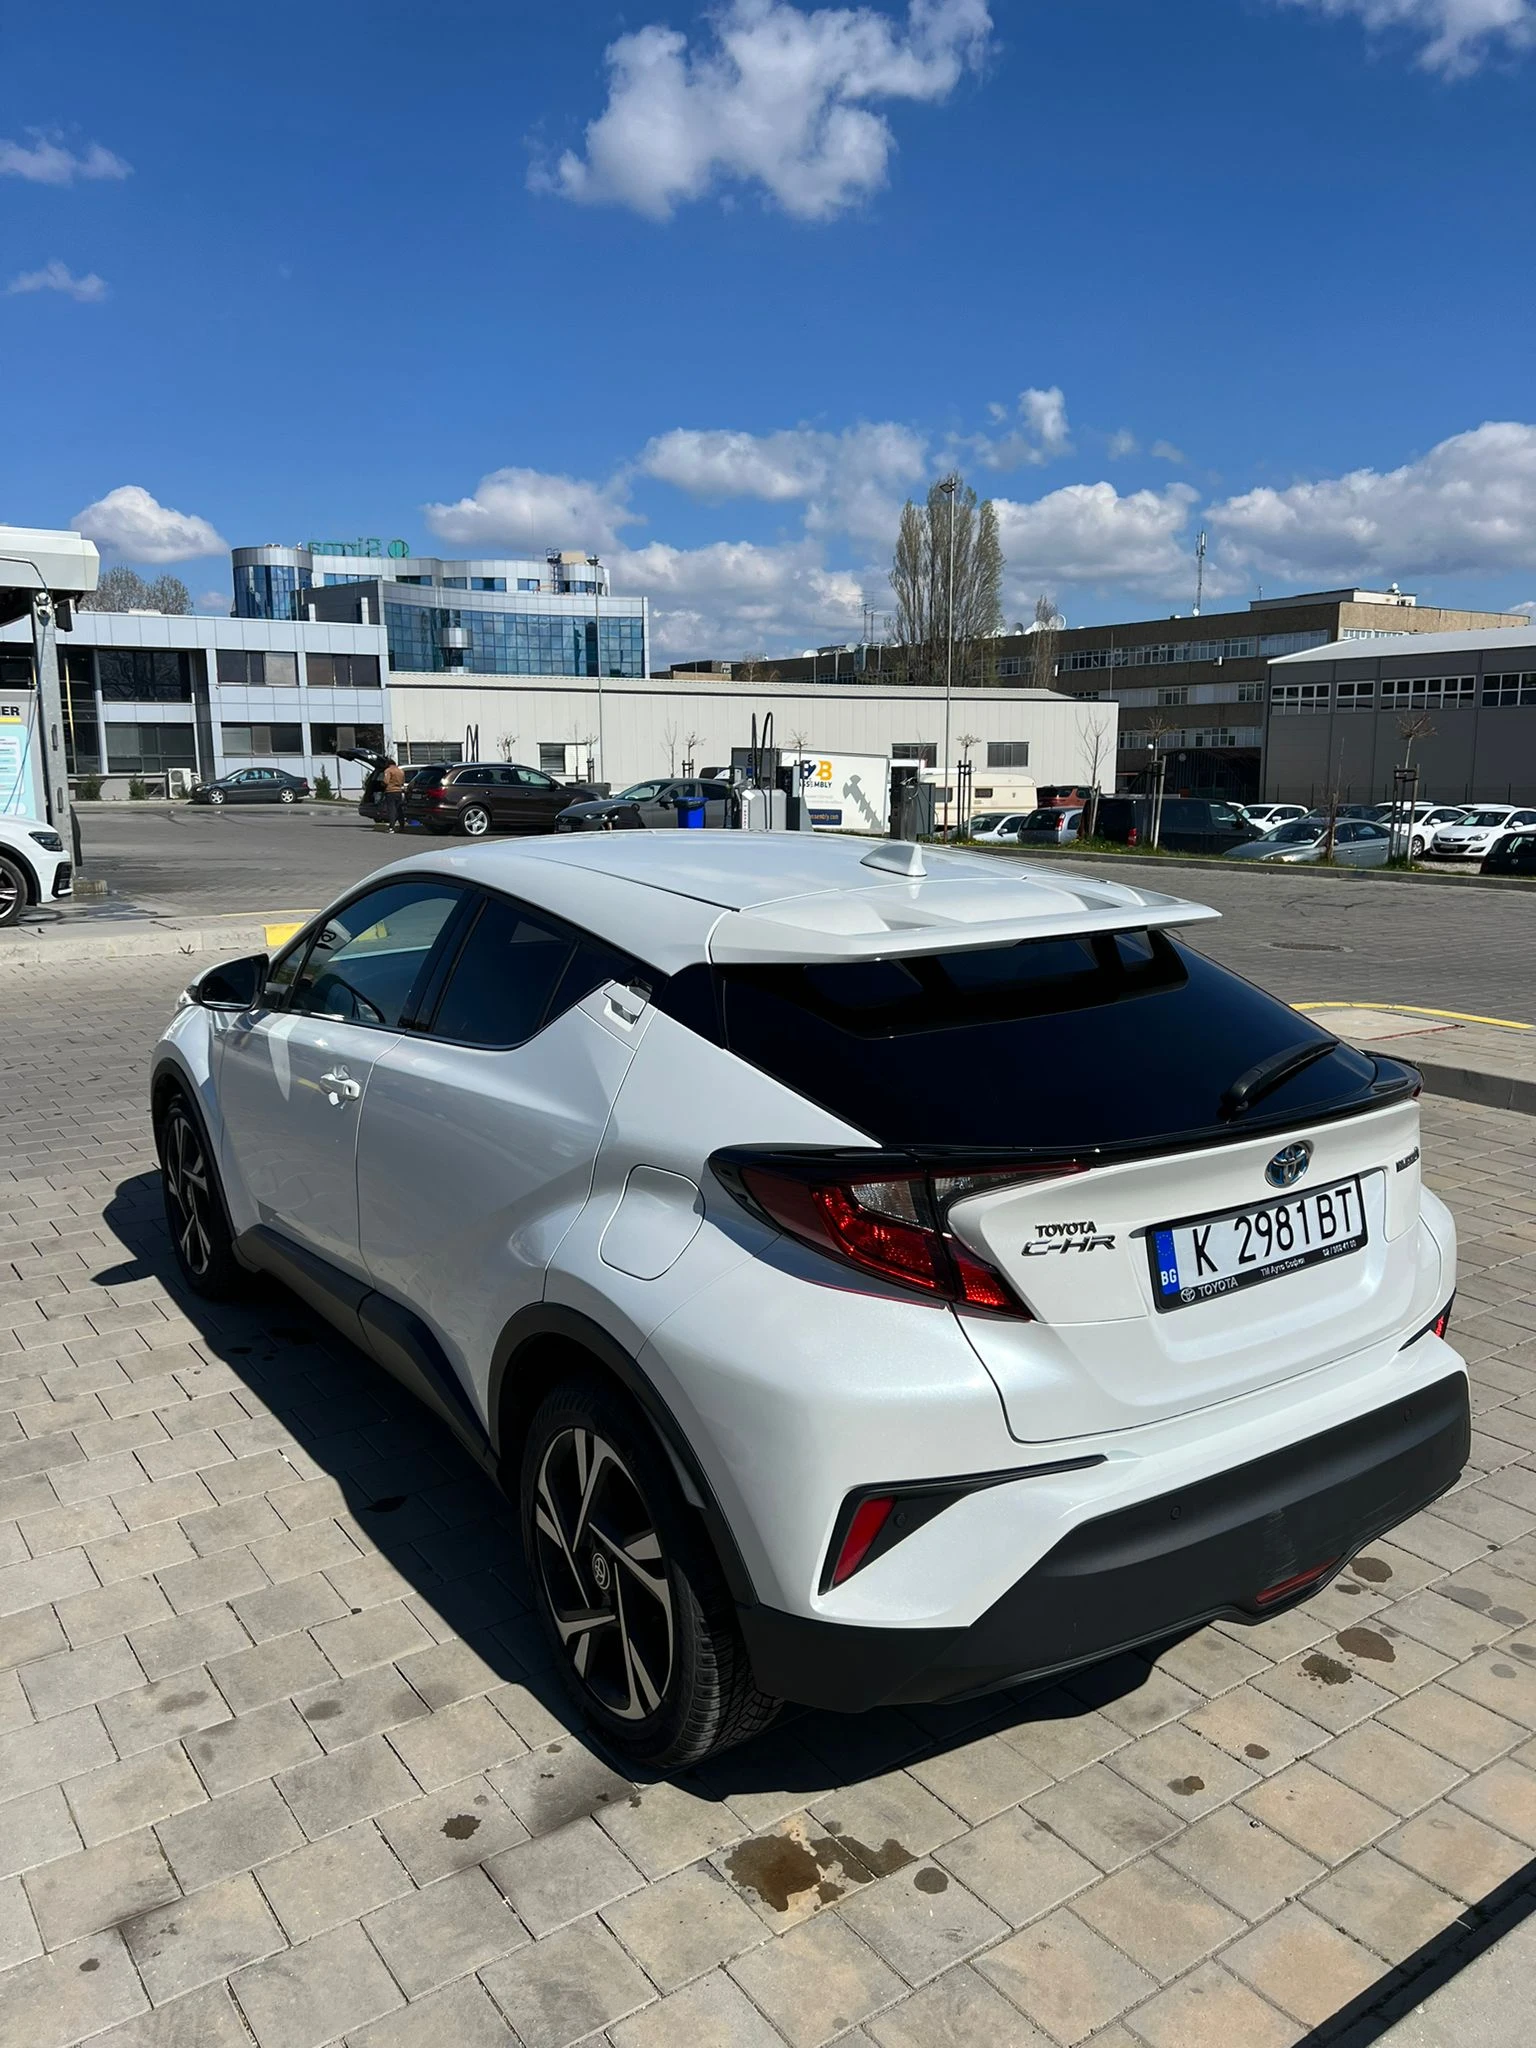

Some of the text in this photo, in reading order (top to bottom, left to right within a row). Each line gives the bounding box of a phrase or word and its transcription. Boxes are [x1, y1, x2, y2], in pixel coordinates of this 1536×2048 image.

[1035, 1221, 1097, 1238] TOYOTA
[1021, 1235, 1116, 1256] C-HR
[1192, 1225, 1219, 1277] K
[1160, 1268, 1177, 1286] BG
[1198, 1277, 1239, 1297] TOYOTA
